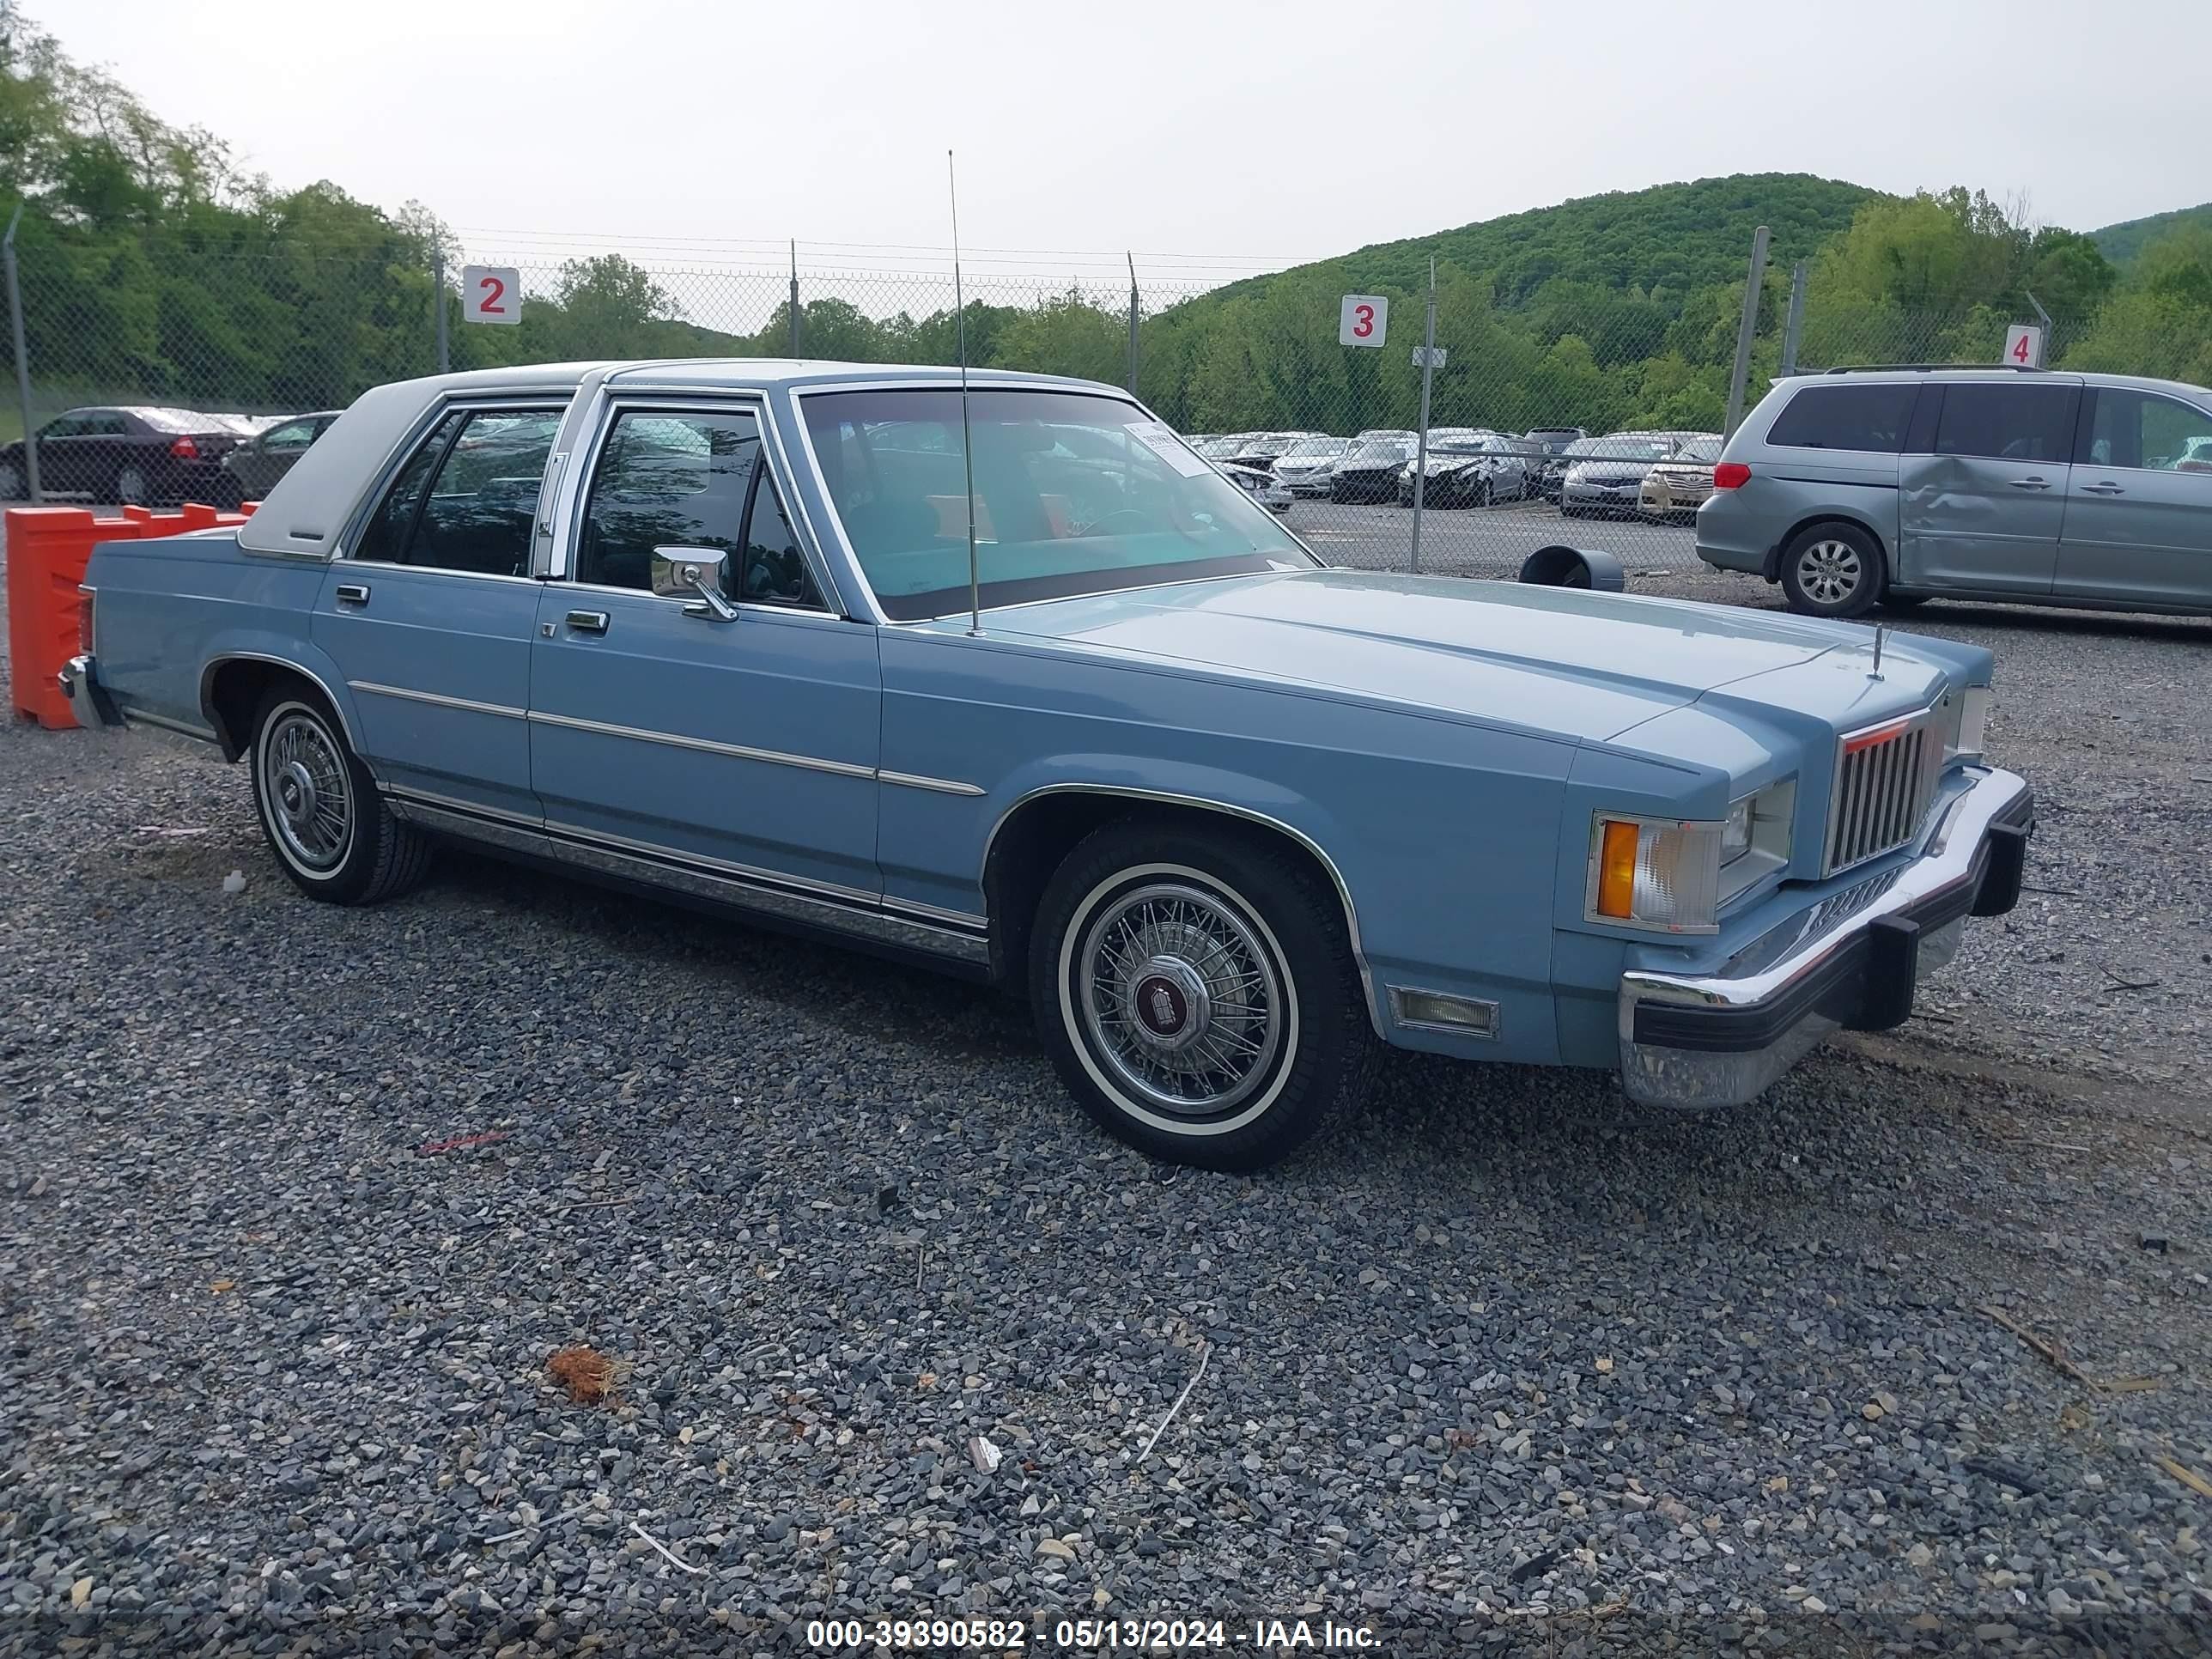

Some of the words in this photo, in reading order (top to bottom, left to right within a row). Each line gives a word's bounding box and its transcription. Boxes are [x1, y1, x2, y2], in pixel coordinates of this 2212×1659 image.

[480, 277, 505, 313] 2
[1353, 305, 1374, 337] 3
[2013, 335, 2029, 363] 4
